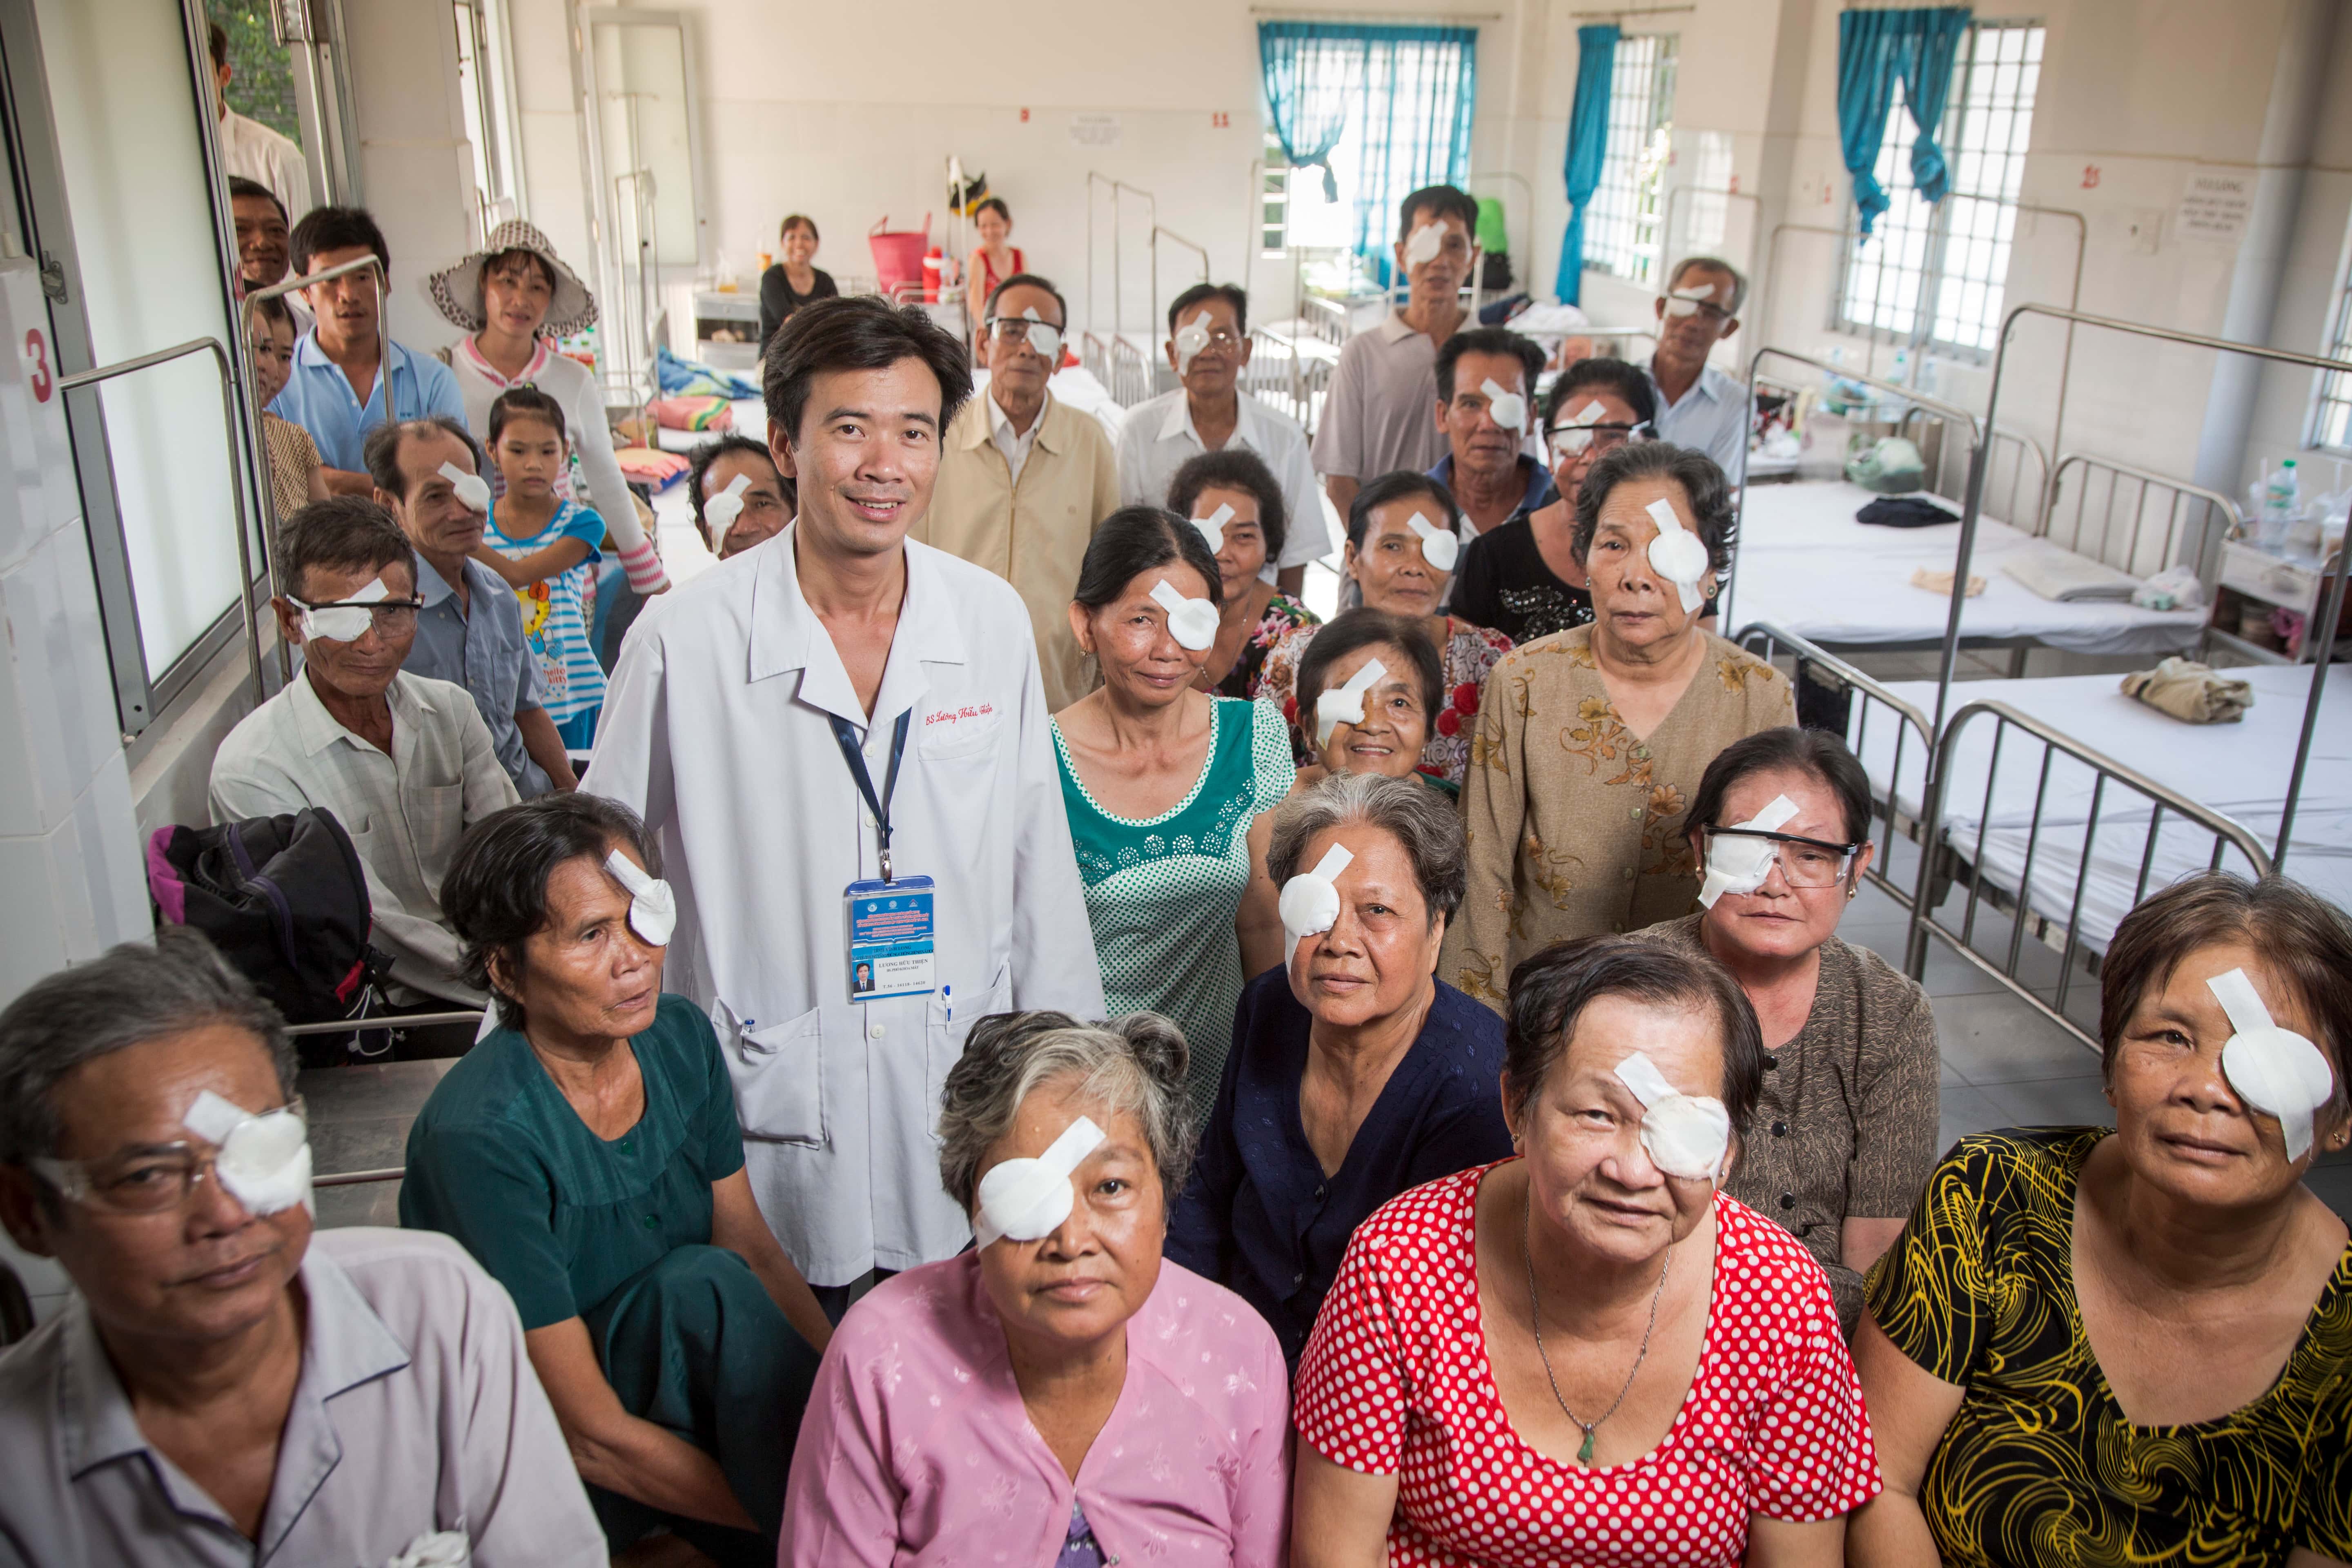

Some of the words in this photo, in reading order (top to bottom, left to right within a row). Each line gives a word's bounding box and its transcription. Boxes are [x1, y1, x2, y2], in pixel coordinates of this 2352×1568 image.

[1212, 112, 1229, 128] 11
[26, 328, 52, 403] 3
[926, 714, 935, 726] BS
